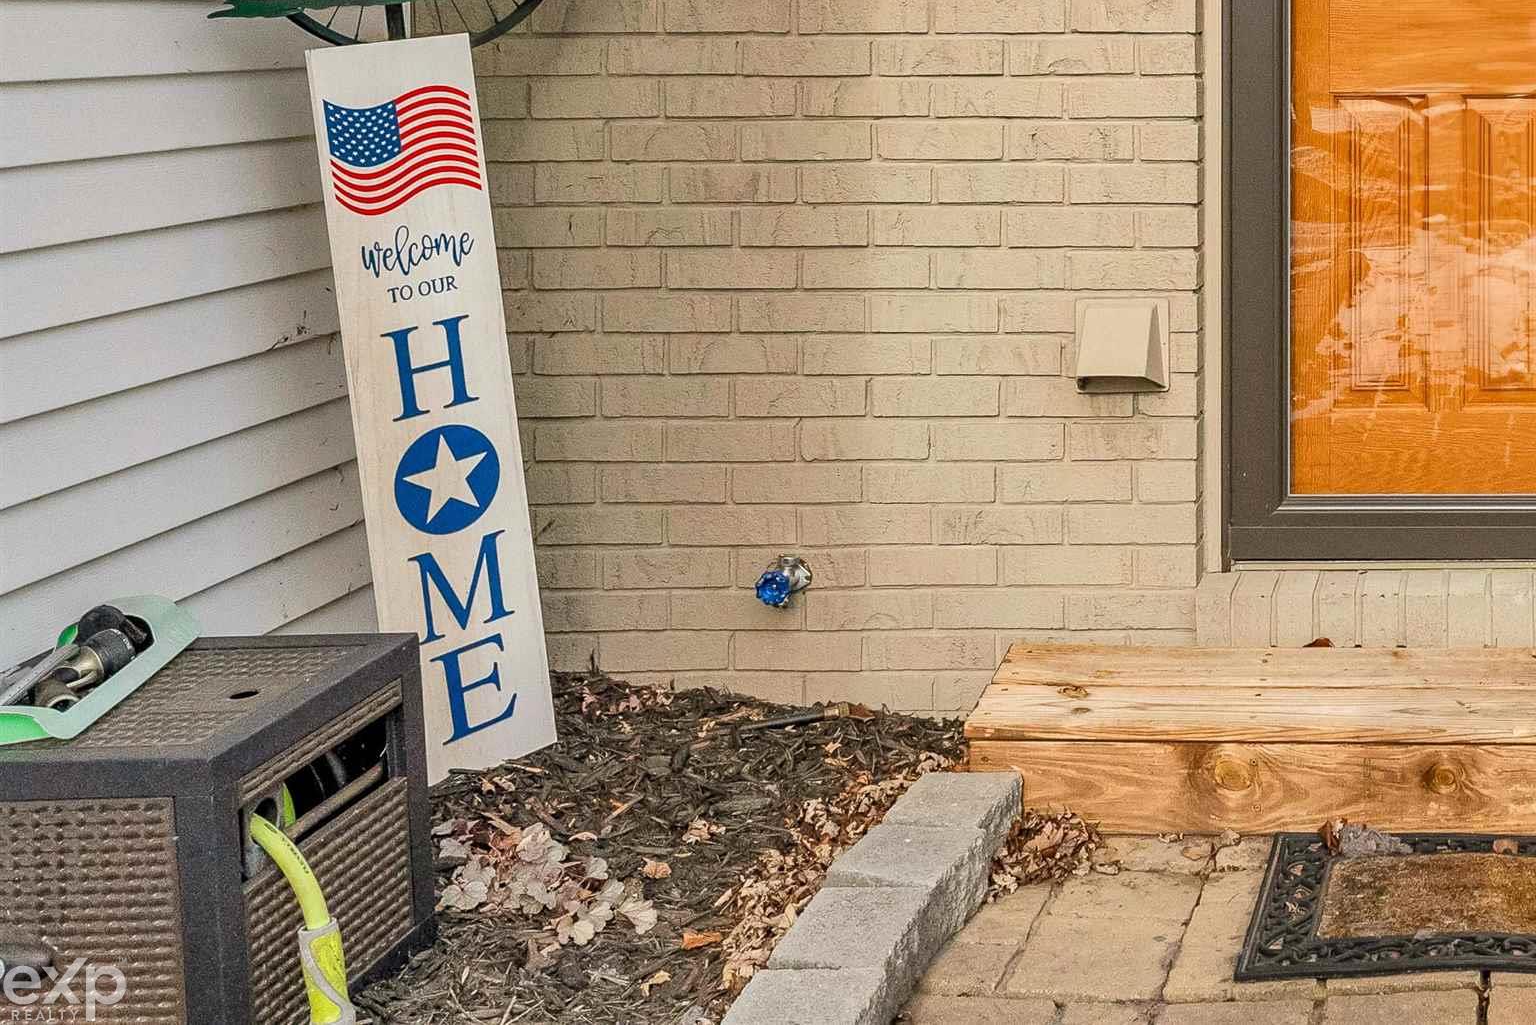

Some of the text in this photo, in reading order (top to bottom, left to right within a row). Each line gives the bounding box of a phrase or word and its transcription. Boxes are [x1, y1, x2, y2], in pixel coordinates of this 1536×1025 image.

[361, 225, 474, 278] welcome
[387, 276, 458, 303] TO OUR
